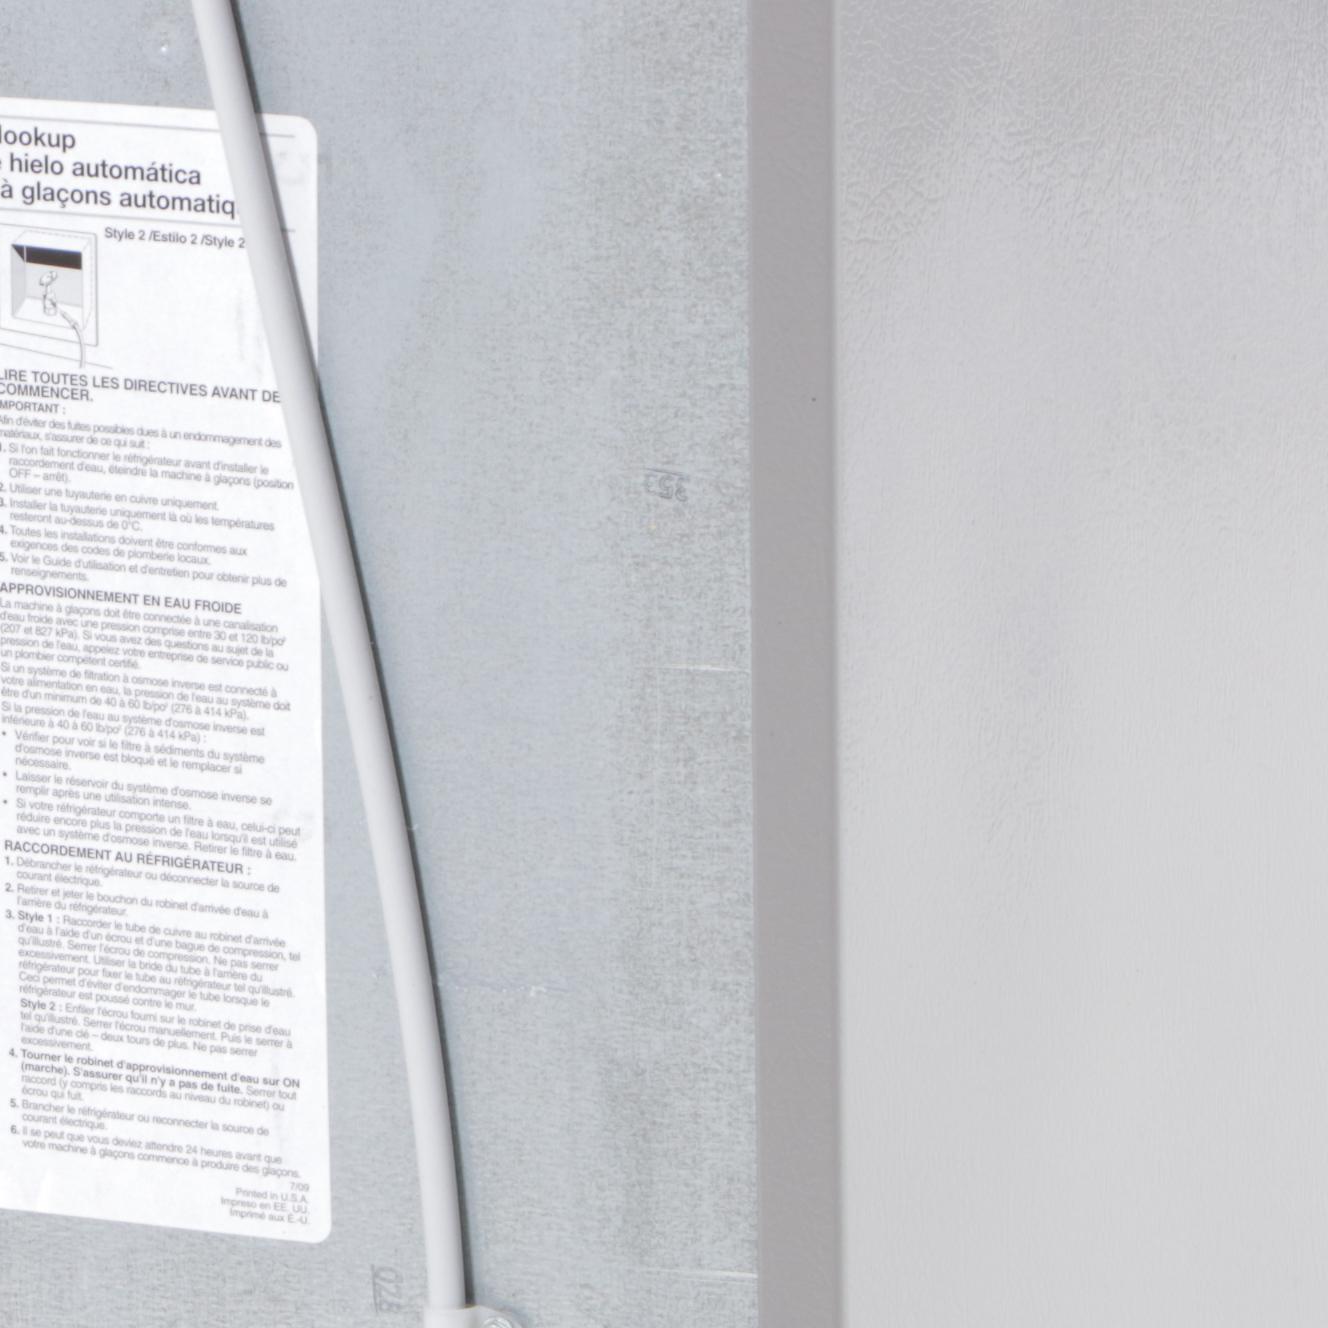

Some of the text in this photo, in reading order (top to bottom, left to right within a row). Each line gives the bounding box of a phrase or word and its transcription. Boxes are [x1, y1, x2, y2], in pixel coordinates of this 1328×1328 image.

[9, 152, 64, 176] hielo
[72, 159, 201, 186] automática
[0, 178, 14, 199] à
[21, 181, 112, 209] glaçons
[119, 190, 235, 220] automatiq
[104, 226, 136, 242] Style
[138, 229, 146, 241] 2
[190, 233, 198, 245] 2
[237, 236, 245, 249] 2
[31, 370, 88, 387] TOUTES
[92, 376, 120, 390] LES
[123, 378, 208, 397] DIRECTIVES
[211, 385, 258, 401] AVANT
[261, 389, 281, 404] DE
[0, 582, 242, 615] APPROVISIONNEMENT EN EAU FROIDE
[4, 839, 112, 861] RACCORDEMENT
[114, 851, 133, 863] AU
[136, 851, 244, 874] RÉFRIGÉRATEUR
[8, 1047, 300, 1089] 4. Tourner le robinet d'approvisionnement d'eau sur ON
